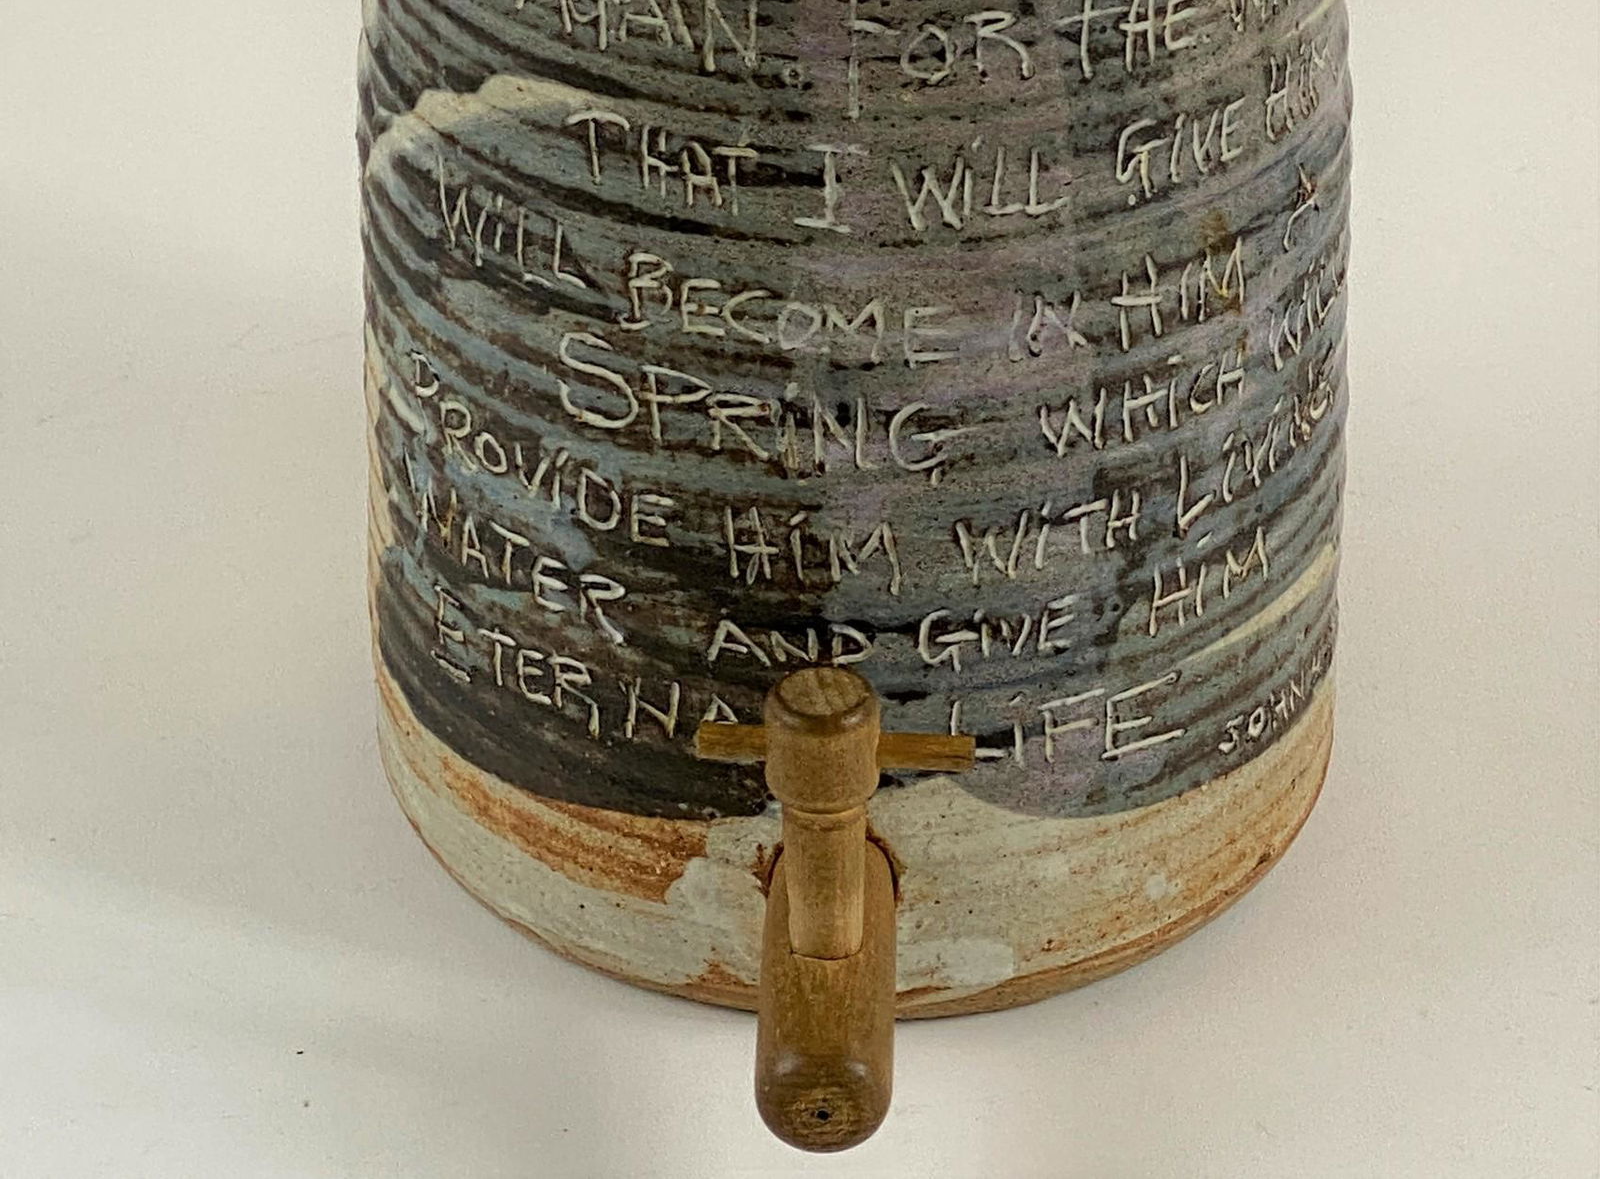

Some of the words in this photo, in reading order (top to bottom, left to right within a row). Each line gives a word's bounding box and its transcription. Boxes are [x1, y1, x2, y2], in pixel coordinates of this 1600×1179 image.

[565, 110, 759, 217] THAT
[794, 142, 868, 234] I
[890, 135, 1071, 231] WILL
[1115, 97, 1246, 198] GIVE
[436, 153, 588, 289] WILL
[616, 251, 960, 369] BECOME
[1008, 289, 1090, 362] IN
[1111, 235, 1246, 352] HIM
[556, 331, 982, 485] SPRING
[1040, 349, 1245, 458] WHICH
[403, 445, 627, 645] WATER
[706, 619, 876, 668] AND
[917, 594, 1077, 674] GIVE
[1149, 526, 1271, 637] HIM
[725, 506, 902, 597] HIM
[955, 489, 1141, 586] WITH
[430, 583, 740, 739] ETERNA
[950, 670, 1187, 768] LIFE
[1218, 670, 1306, 754] JOHN
